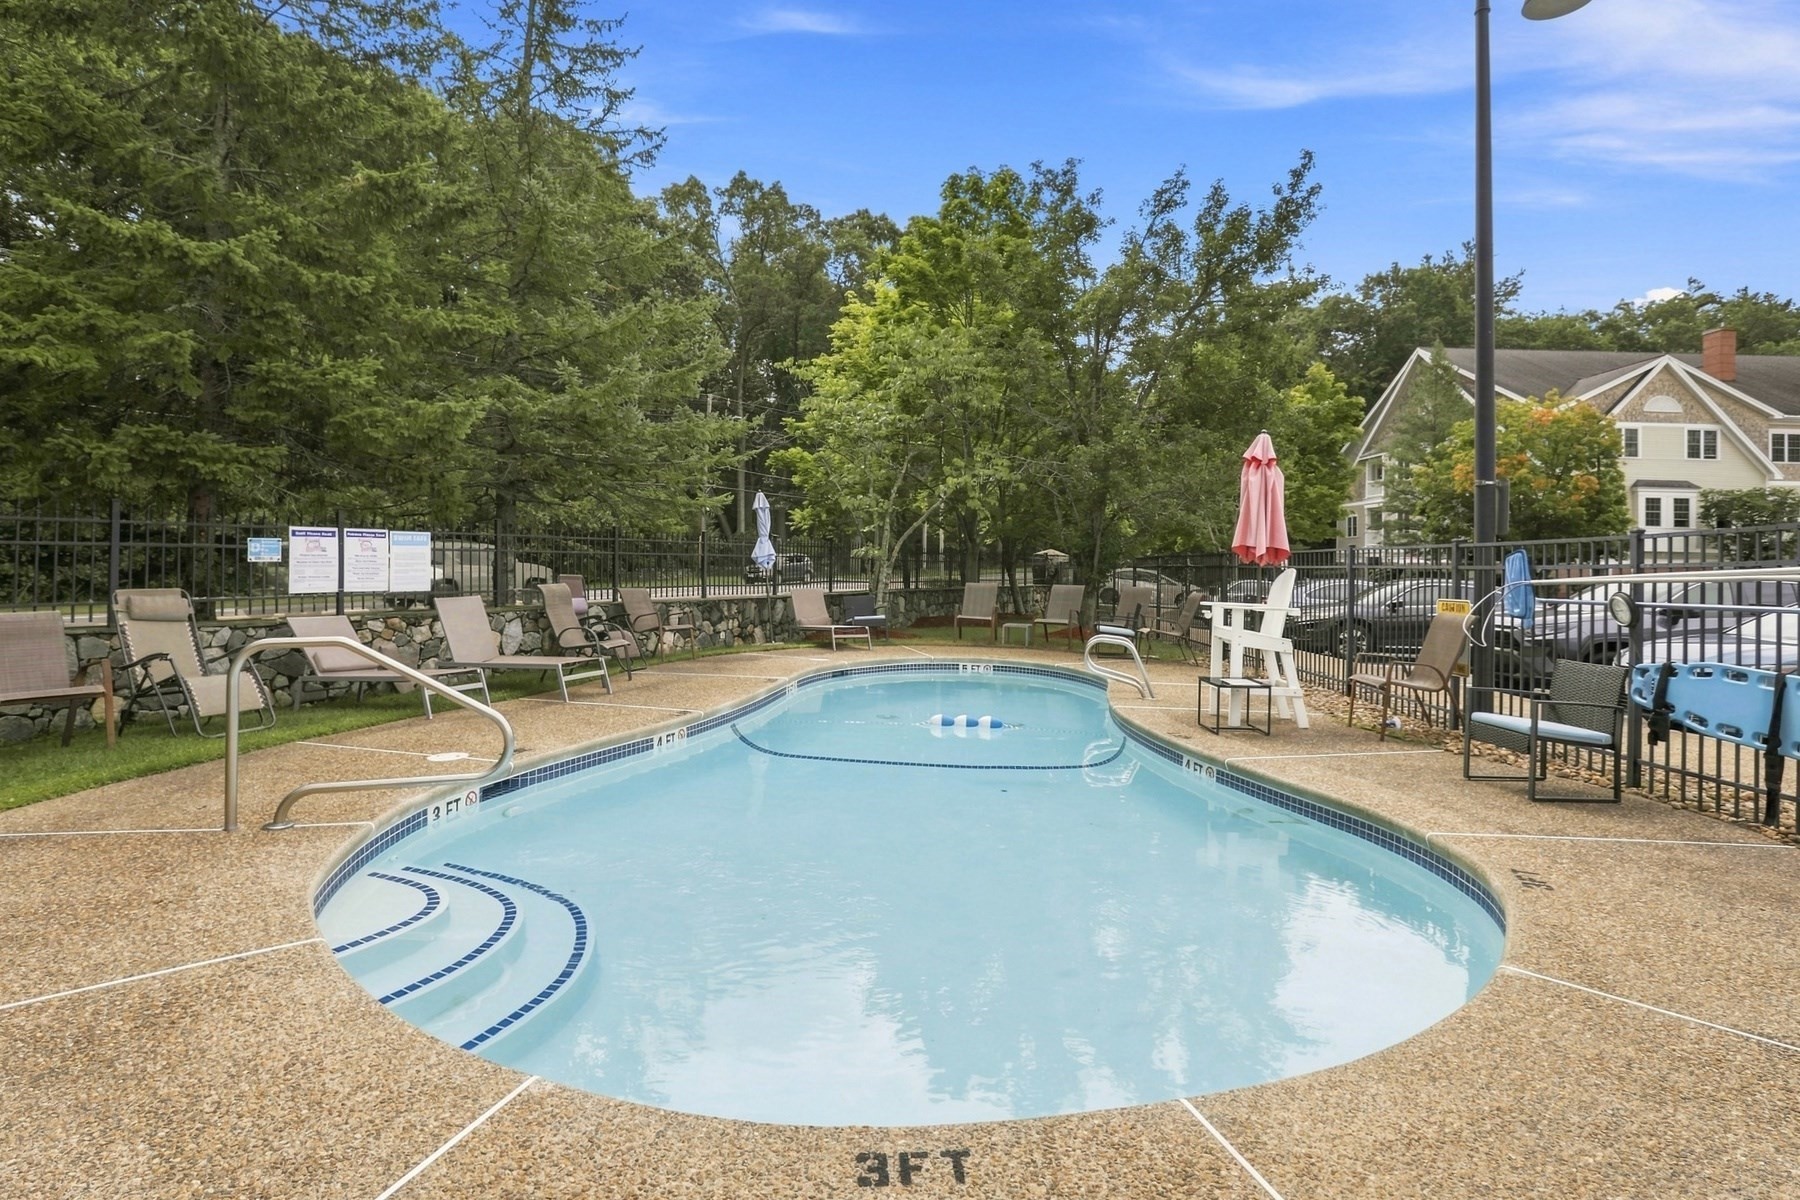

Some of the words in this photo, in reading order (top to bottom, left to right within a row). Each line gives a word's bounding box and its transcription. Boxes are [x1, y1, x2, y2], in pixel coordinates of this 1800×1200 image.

[665, 732, 676, 744] FT
[1193, 761, 1203, 774] FT
[432, 806, 441, 821] 3
[446, 797, 462, 815] FT
